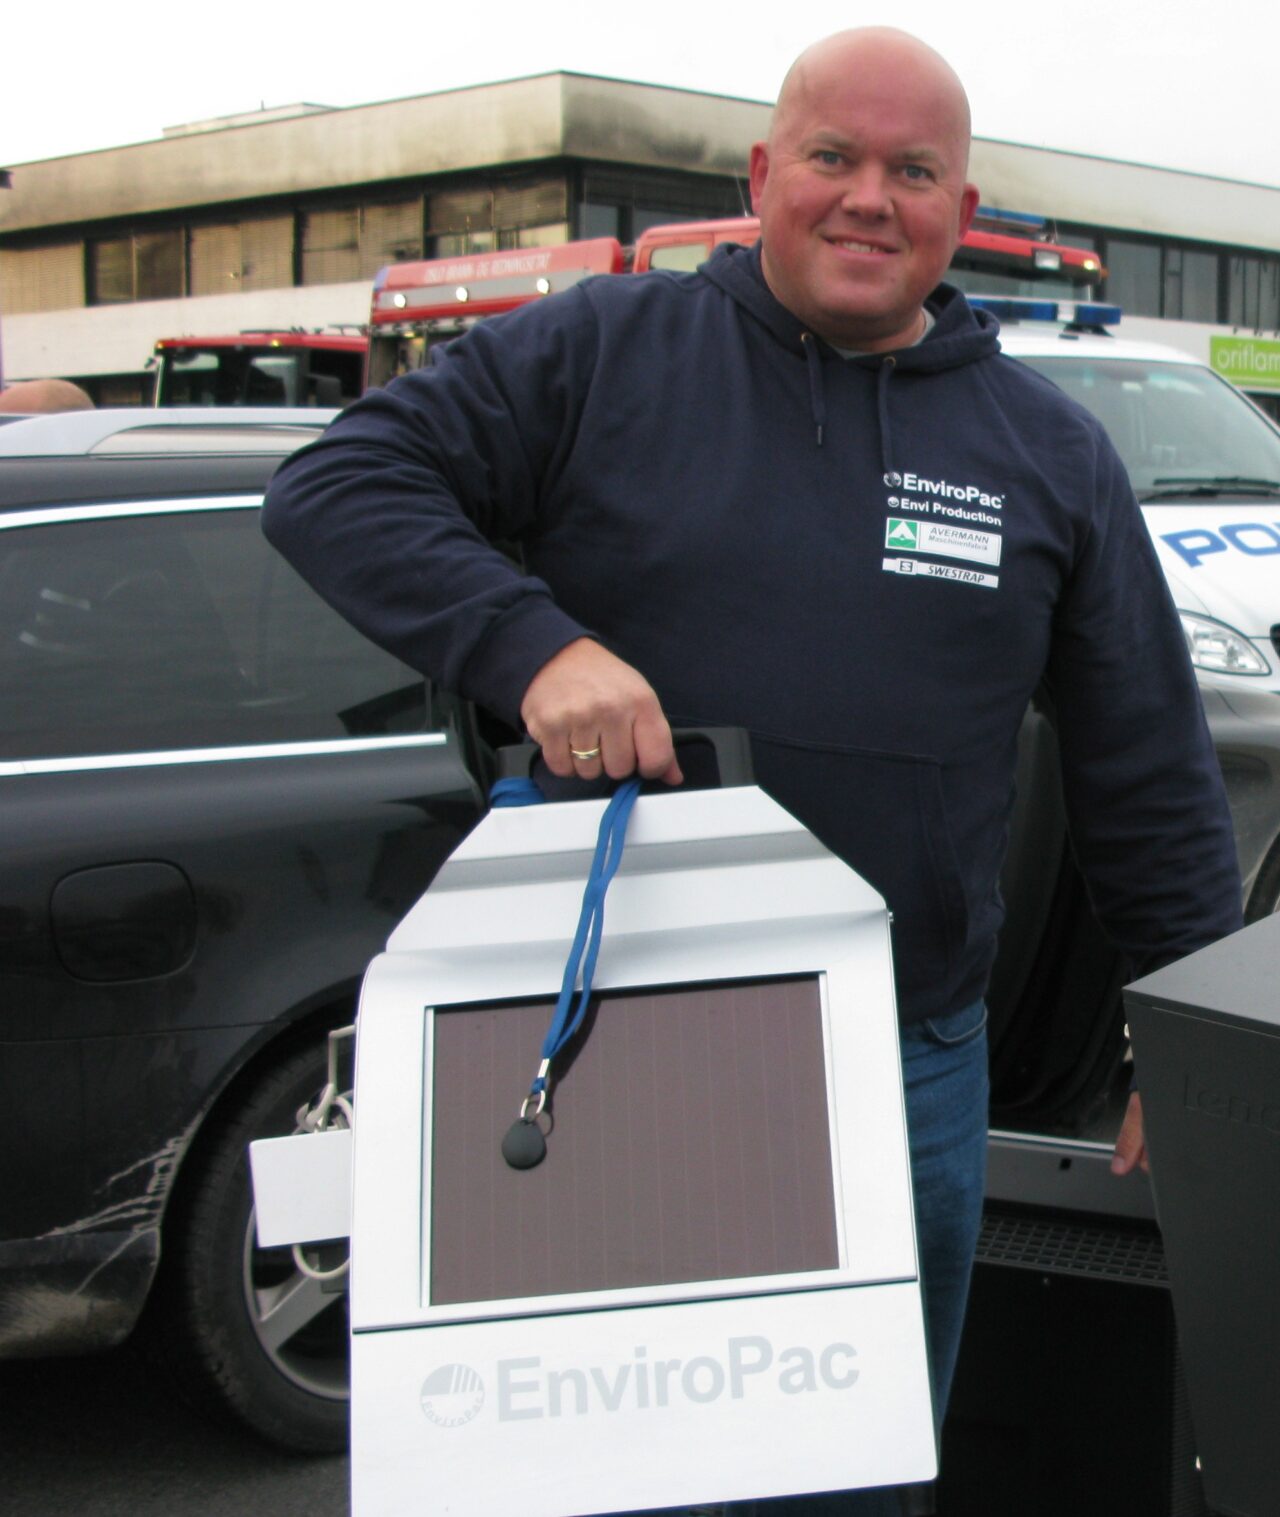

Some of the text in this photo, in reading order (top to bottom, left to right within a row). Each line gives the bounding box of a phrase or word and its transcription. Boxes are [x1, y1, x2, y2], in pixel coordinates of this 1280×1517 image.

[903, 473, 1003, 509] EnviroPac
[901, 498, 1002, 527] Envi Production
[930, 526, 990, 545] AVERMANN
[927, 565, 985, 583] SWESTRAP
[497, 1335, 860, 1422] EnviroPac
